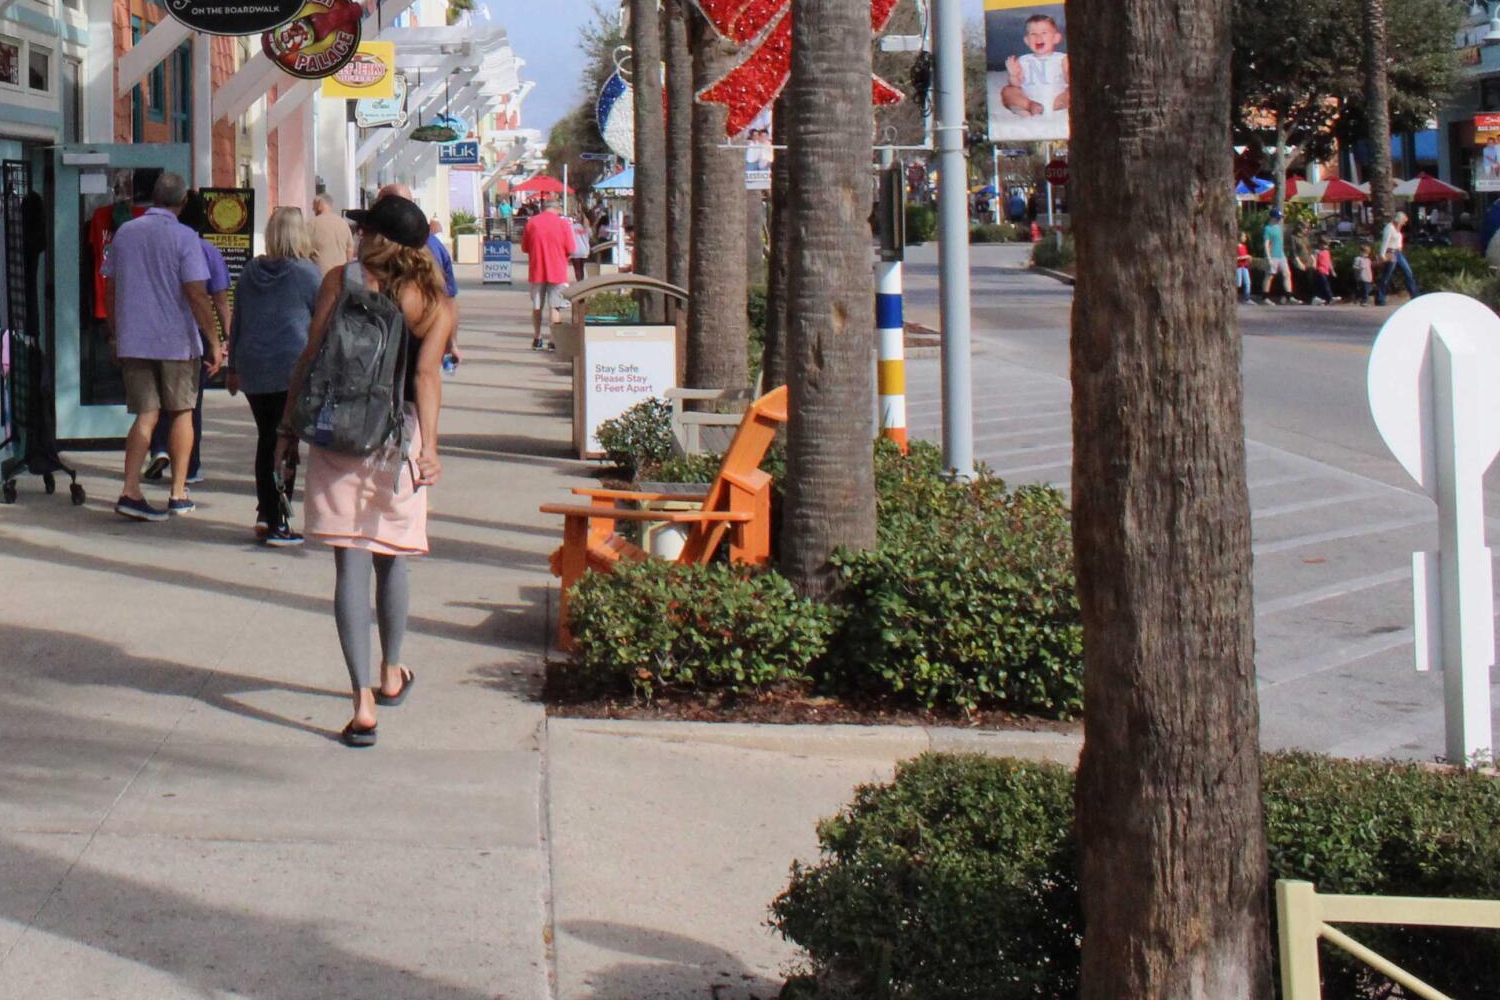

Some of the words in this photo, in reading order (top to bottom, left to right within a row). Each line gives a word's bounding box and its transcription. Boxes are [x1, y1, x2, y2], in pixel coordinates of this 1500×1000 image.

[191, 7, 205, 16] ON
[207, 6, 223, 15] THE
[225, 5, 280, 14] BOARDWALK
[294, 30, 355, 72] PALACE
[355, 62, 387, 75] JERKY
[1047, 168, 1070, 178] STOP
[615, 188, 634, 197] FIDG
[484, 263, 508, 271] NOW
[484, 271, 511, 279] OPEN
[595, 364, 616, 374] Stay
[618, 364, 640, 373] Safe
[595, 374, 626, 383] Please
[627, 374, 648, 383] Stay
[595, 383, 602, 392] 6
[604, 383, 625, 392] Feet
[626, 383, 653, 394] Apart
